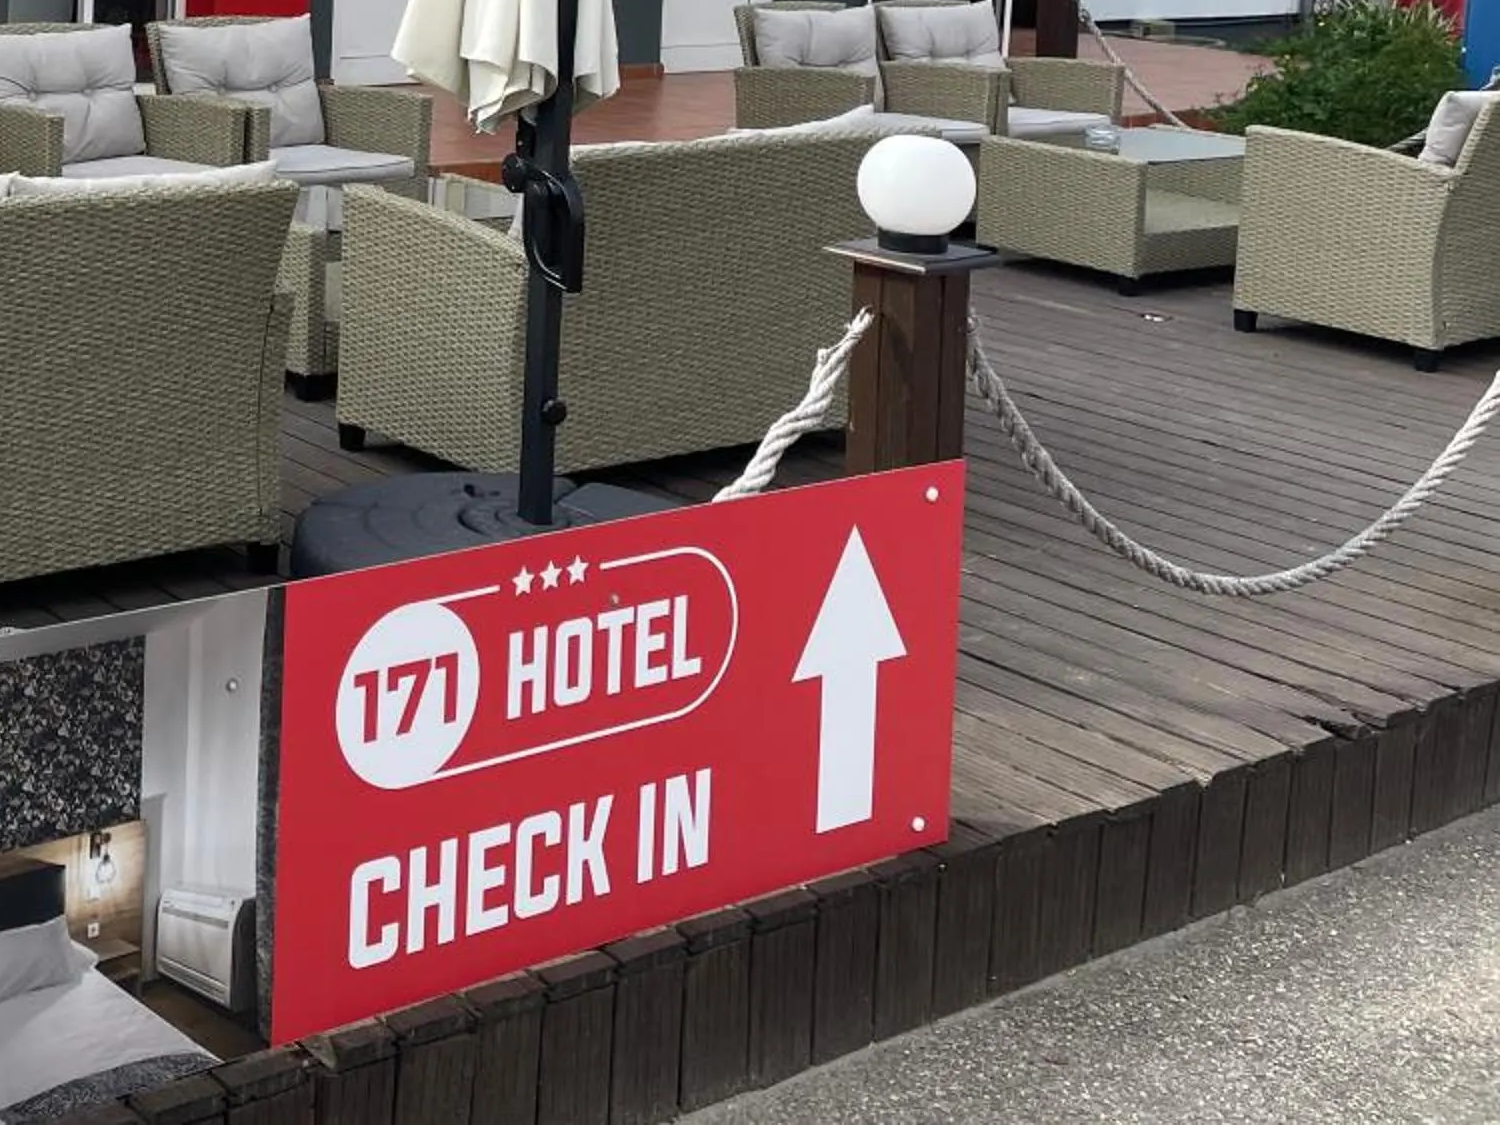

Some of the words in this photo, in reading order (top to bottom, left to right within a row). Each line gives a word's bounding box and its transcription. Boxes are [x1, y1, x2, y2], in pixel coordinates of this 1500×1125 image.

[353, 651, 460, 744] 171
[507, 594, 702, 721] HOTEL
[348, 794, 614, 970] CHECK
[637, 768, 712, 884] IN
